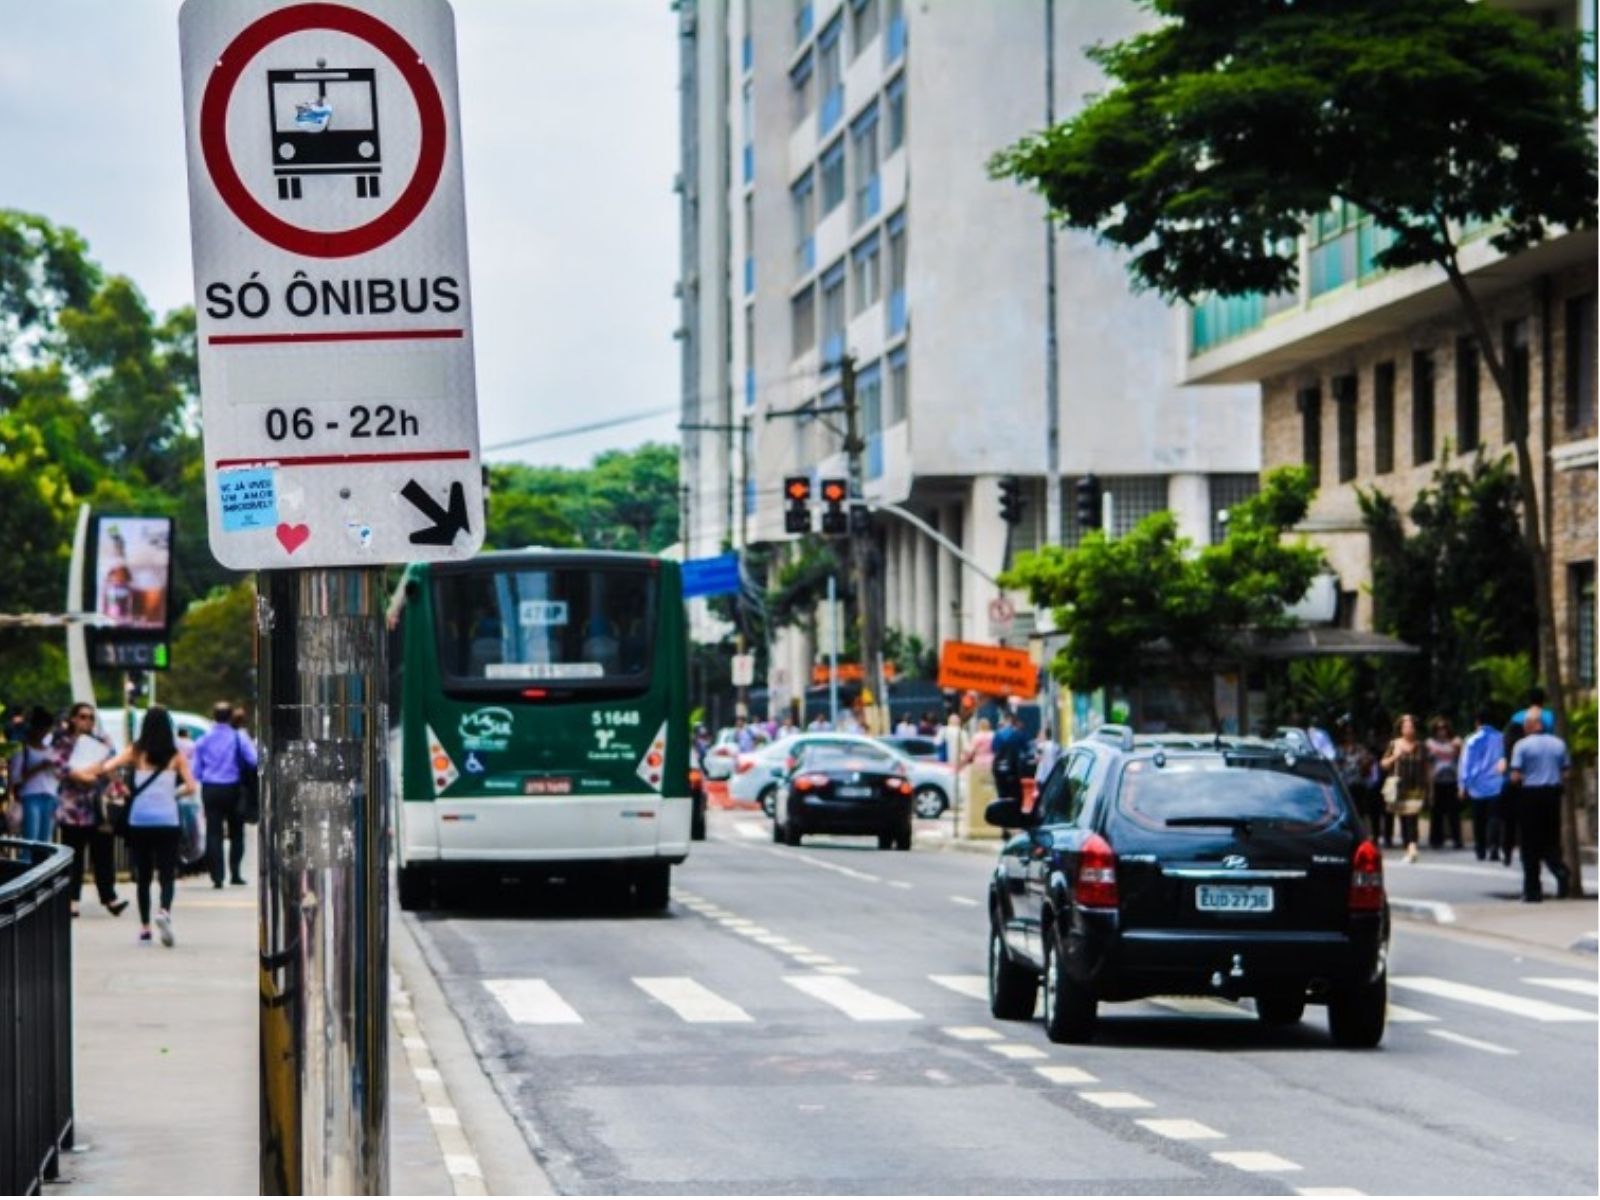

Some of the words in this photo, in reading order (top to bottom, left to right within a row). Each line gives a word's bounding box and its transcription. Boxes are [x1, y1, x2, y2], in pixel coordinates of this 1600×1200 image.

[205, 272, 271, 319] SÓ
[285, 270, 461, 317] ÔNIBUS
[265, 408, 315, 441] 06
[349, 405, 419, 438] 22h
